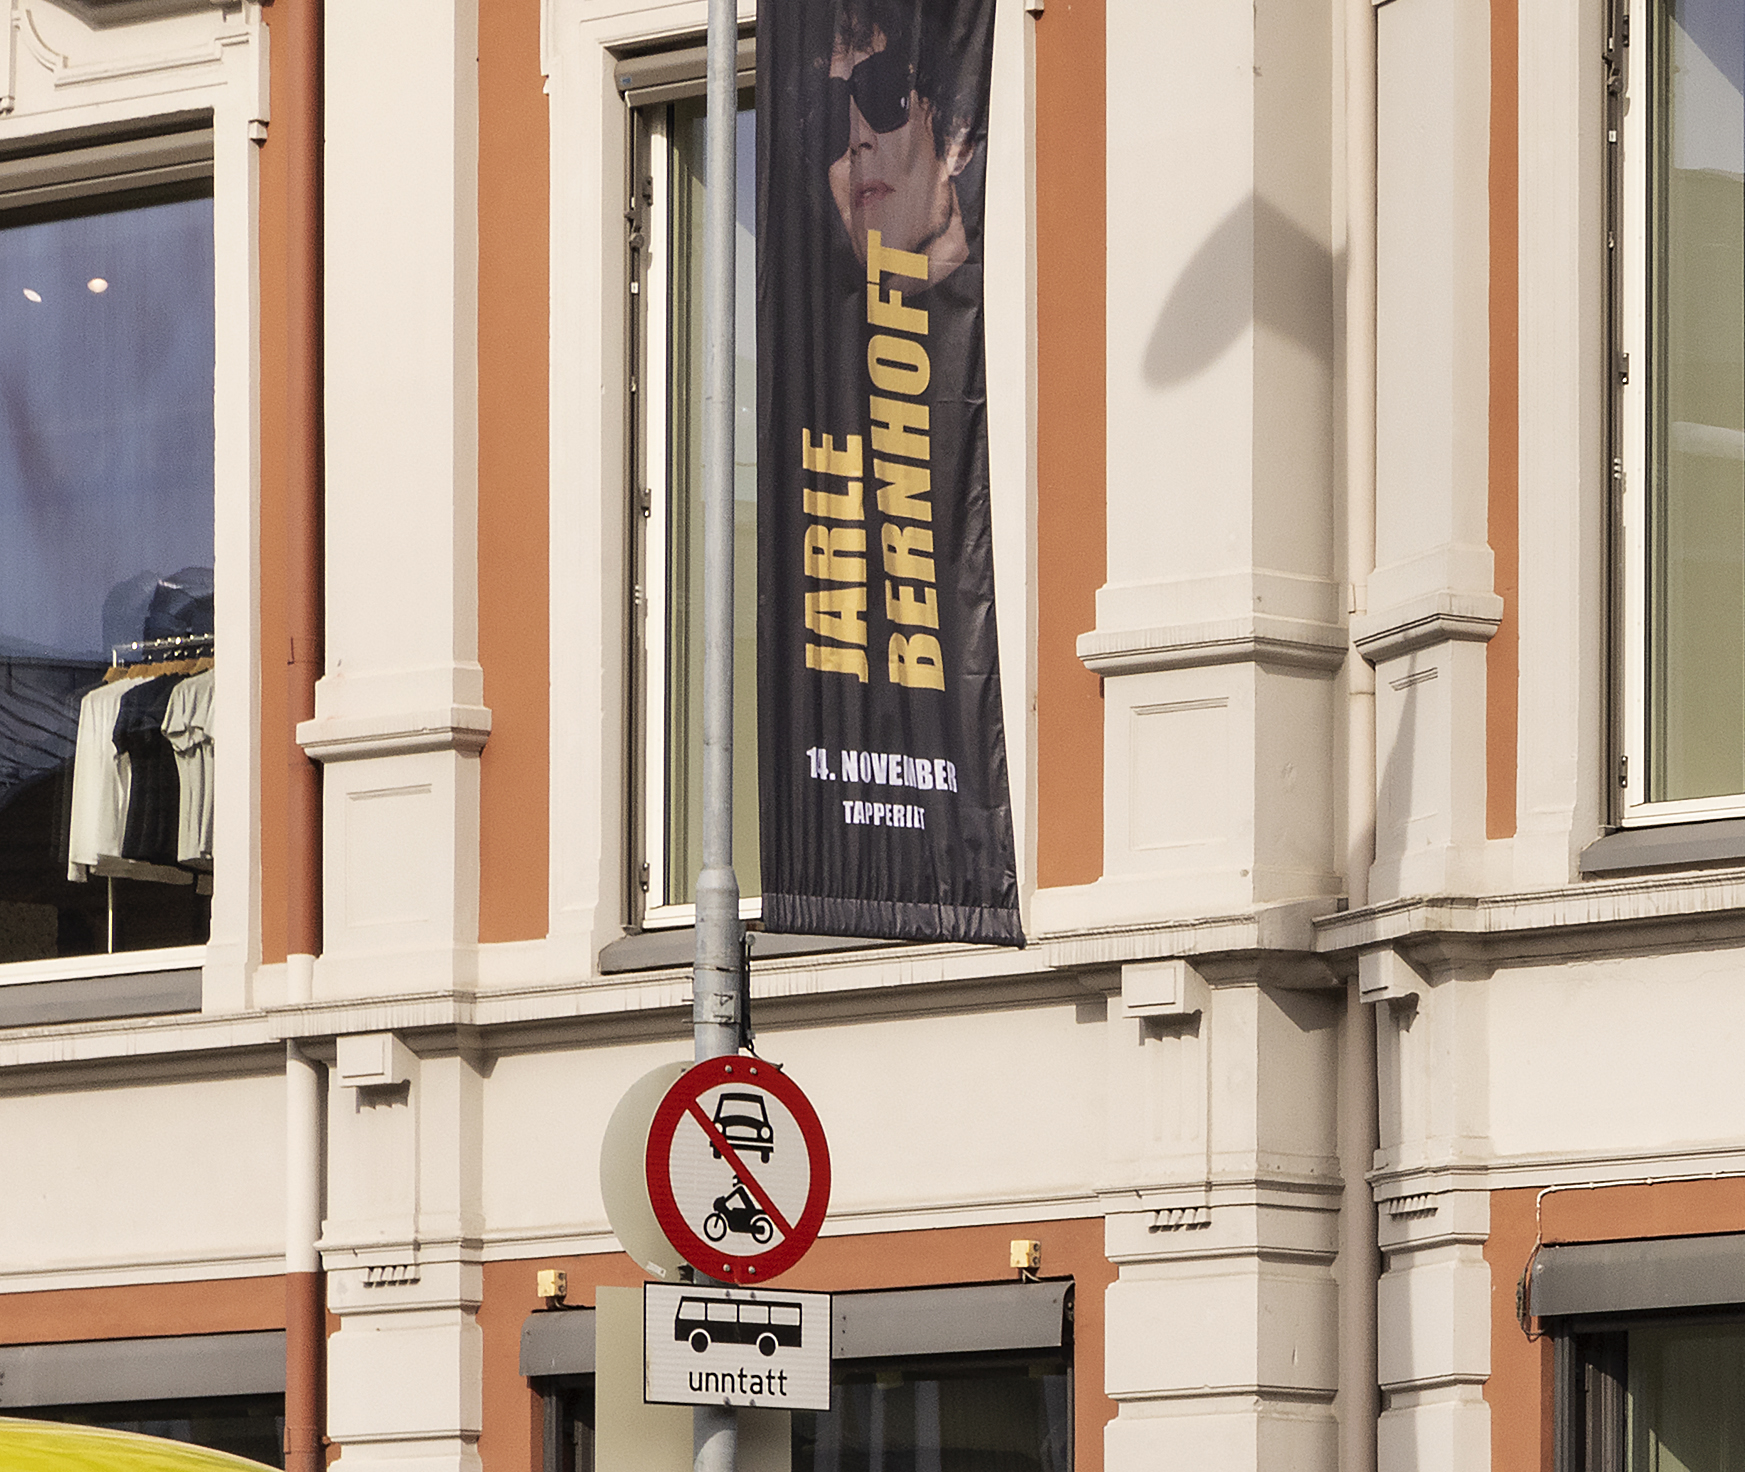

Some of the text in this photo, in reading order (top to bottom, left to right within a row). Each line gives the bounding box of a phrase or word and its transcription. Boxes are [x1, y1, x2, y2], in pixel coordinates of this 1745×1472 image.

[866, 229, 946, 692] BERNHOFT
[802, 427, 869, 684] JARLE
[806, 746, 958, 793] 14. NOVEMBER
[689, 1367, 788, 1396] unntatt
